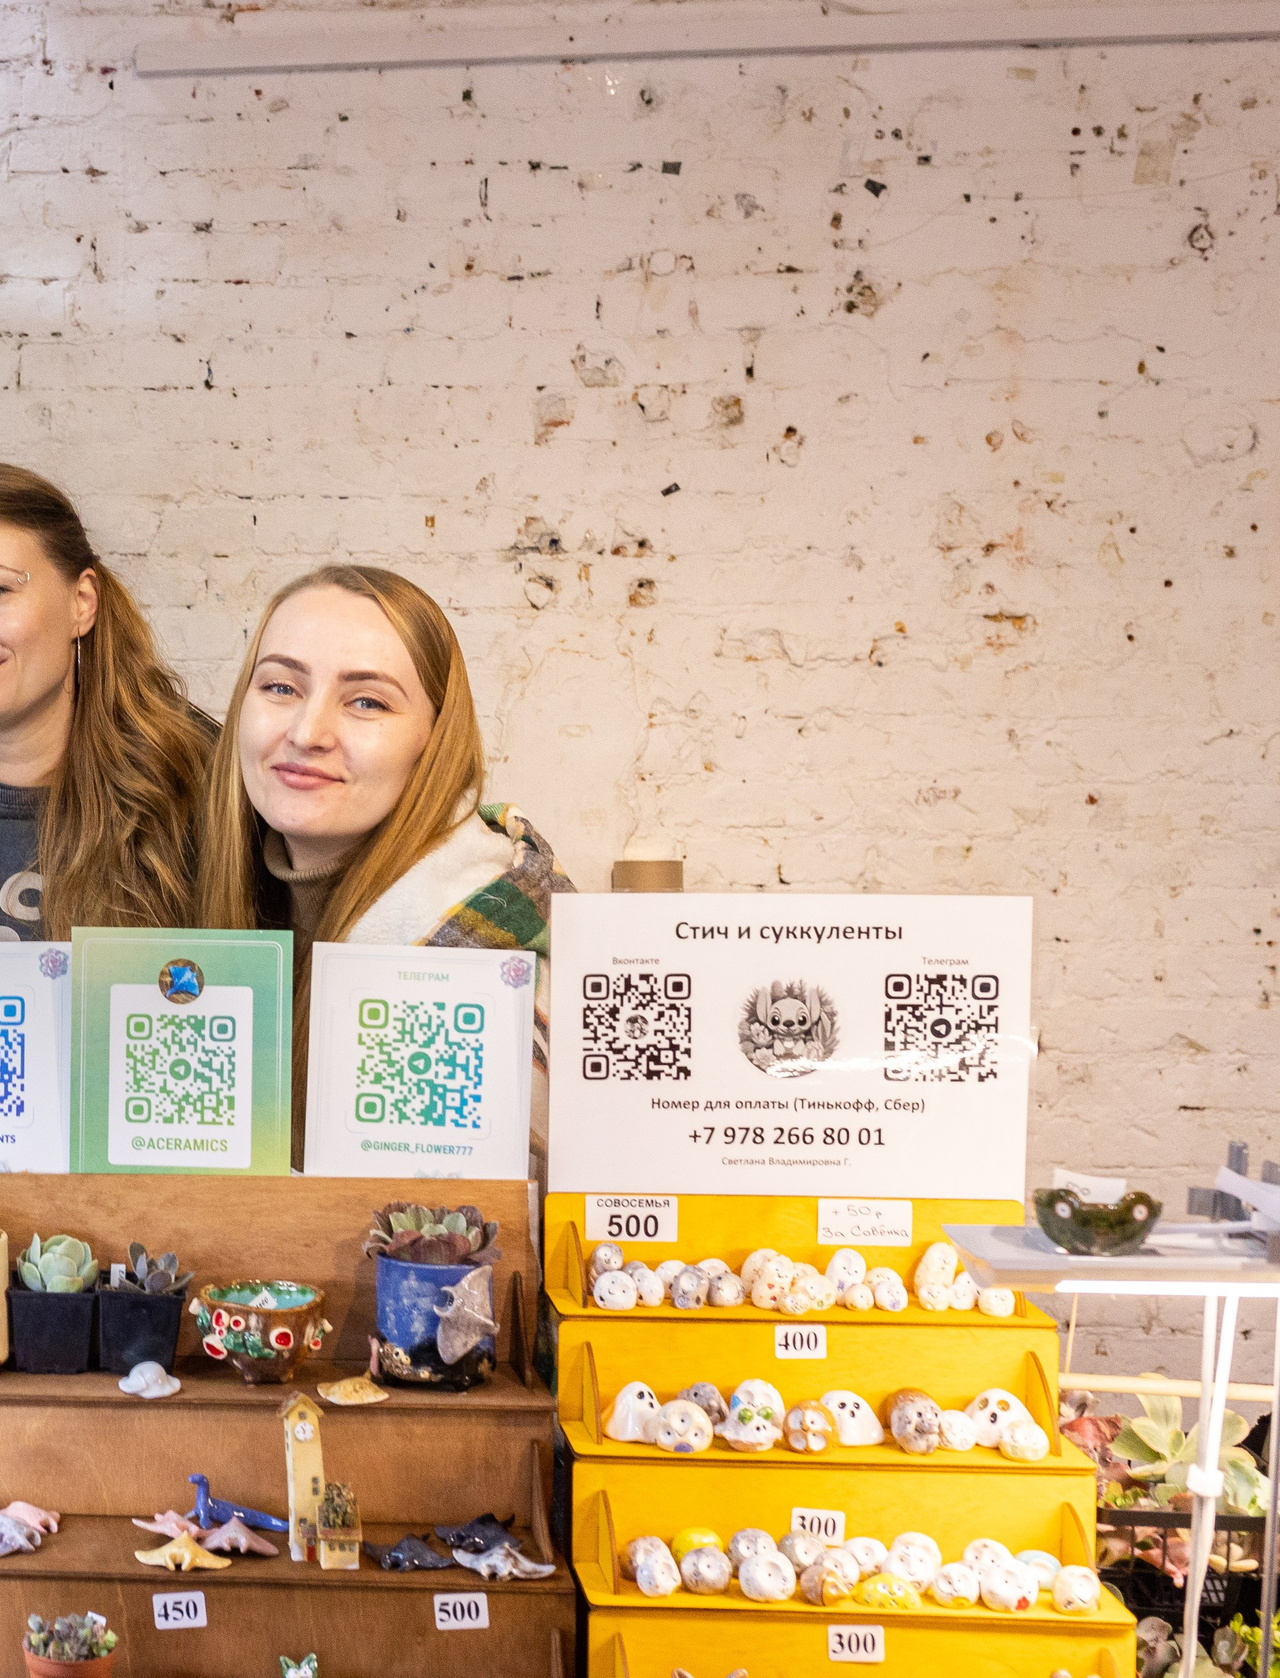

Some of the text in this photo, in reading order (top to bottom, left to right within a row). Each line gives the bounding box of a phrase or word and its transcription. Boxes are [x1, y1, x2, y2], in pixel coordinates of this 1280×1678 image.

[675, 921, 903, 944] Стич и суккуленты
[611, 956, 660, 966] Вконтакте
[921, 956, 969, 967] Телеграм
[396, 970, 450, 982] ТЕЛЕГРАМ
[651, 1098, 926, 1113] Номер для оплаты (Тинькофф, Сбер)
[131, 1136, 228, 1153] @ACERAMICS
[688, 1126, 886, 1146] +7 978 266 80 01
[360, 1139, 474, 1156] @GINGER_FLOWER777
[721, 1156, 766, 1166] Светлана
[768, 1156, 841, 1168] Владимировна
[596, 1198, 670, 1208] СОВОСЕМЬЯ
[607, 1213, 659, 1238] 500
[822, 1226, 846, 1238] За
[778, 1331, 818, 1351] 400
[797, 1514, 837, 1537] 300
[158, 1599, 198, 1621] 450
[438, 1600, 480, 1622] 500
[831, 1632, 876, 1655] 300
